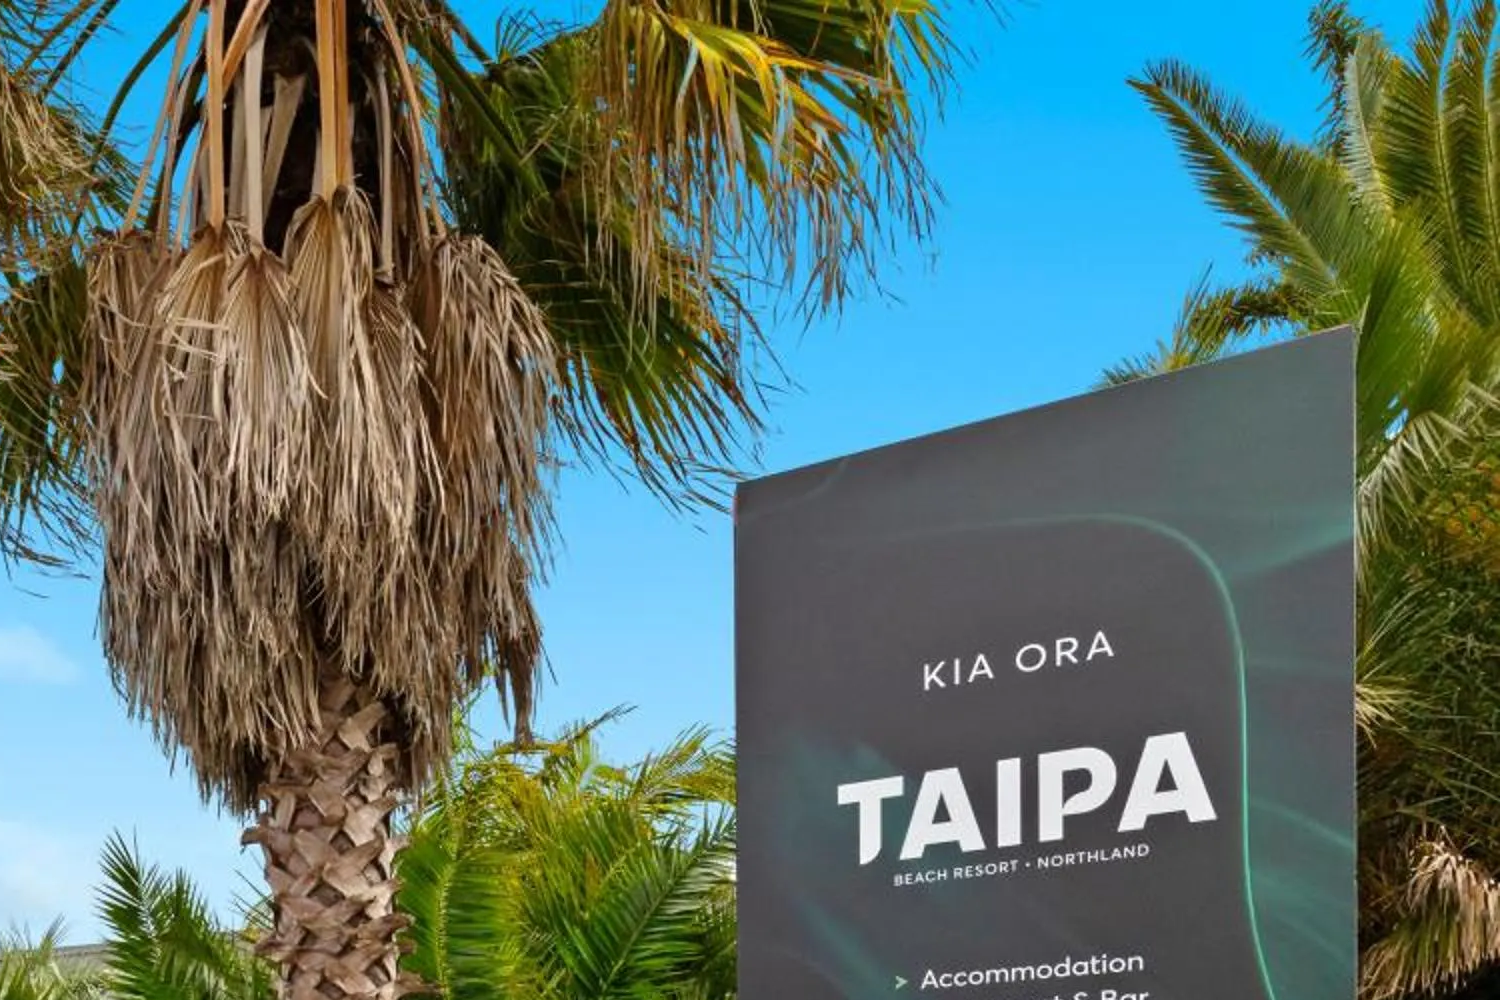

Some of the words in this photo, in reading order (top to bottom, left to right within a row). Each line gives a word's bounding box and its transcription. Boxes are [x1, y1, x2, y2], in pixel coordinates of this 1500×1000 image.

[922, 653, 995, 692] KIA
[1014, 630, 1115, 673] ORA
[836, 730, 1218, 866] TAIPA
[893, 869, 948, 887] BEACH
[953, 860, 1019, 879] RESORT
[1037, 843, 1151, 869] NORTHLAND
[920, 953, 1145, 990] Accommodation
